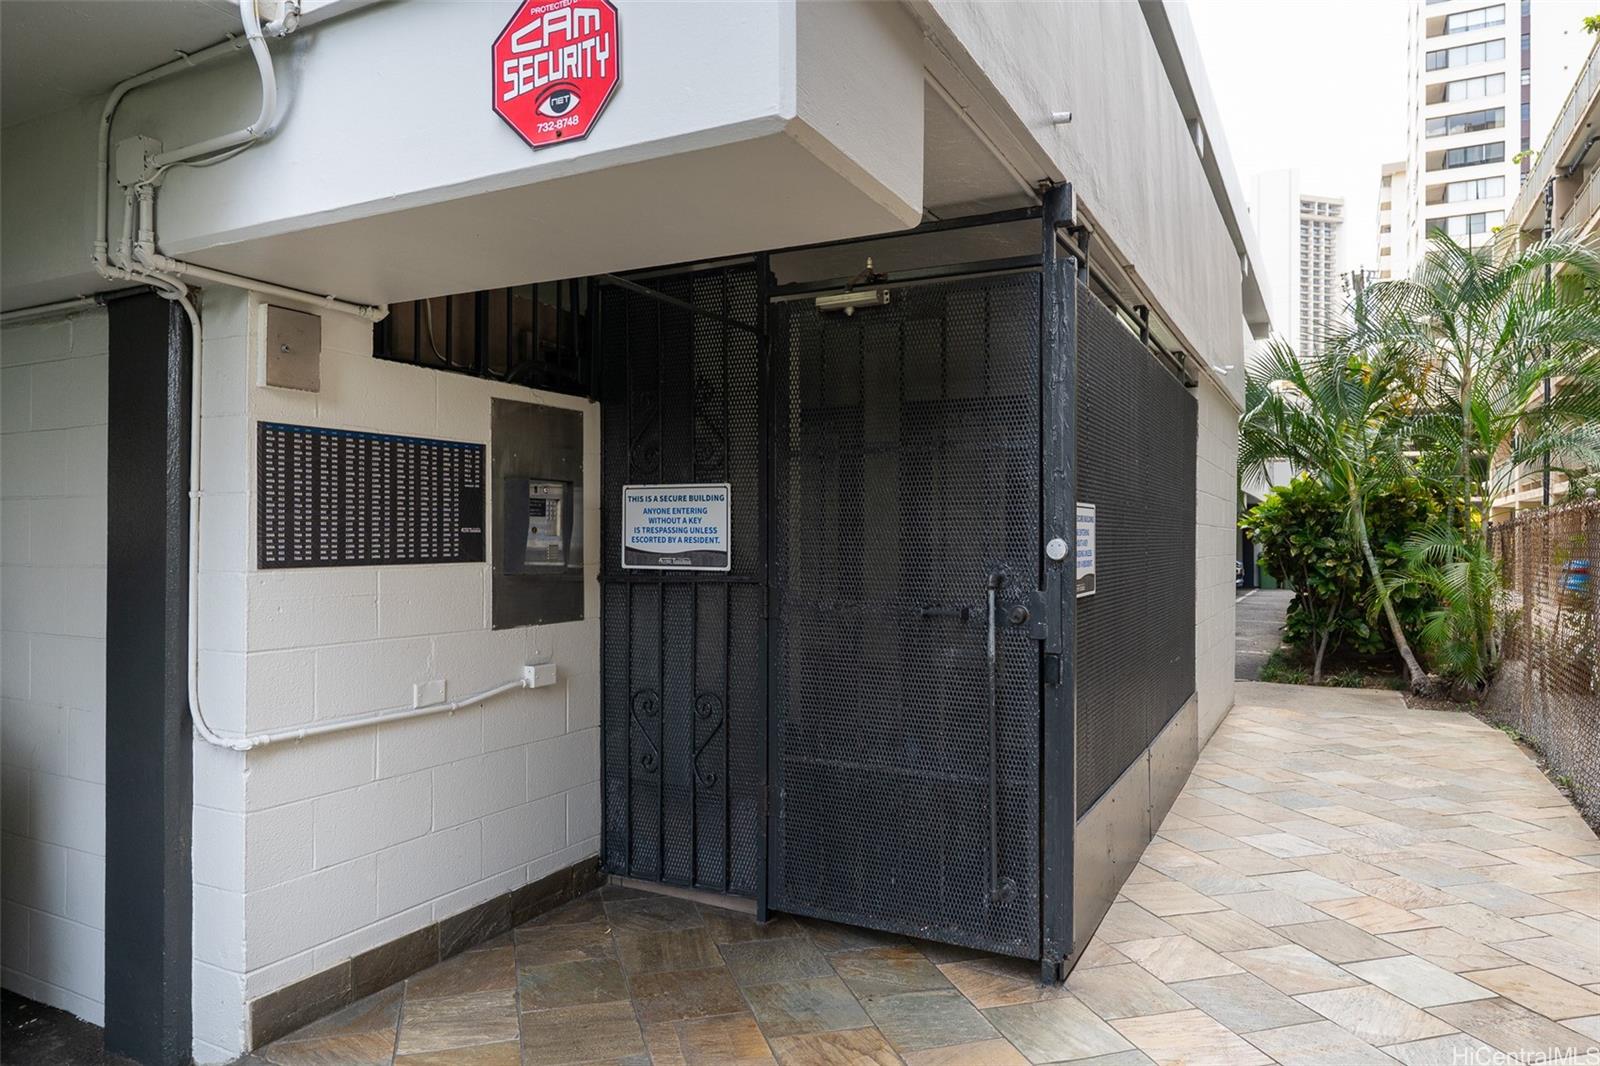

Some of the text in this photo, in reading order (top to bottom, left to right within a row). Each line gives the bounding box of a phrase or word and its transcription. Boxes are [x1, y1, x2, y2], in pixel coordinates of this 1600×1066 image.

[511, 7, 600, 53] CAM
[503, 32, 609, 102] SECURITY
[536, 115, 579, 133] 732-8748
[689, 494, 725, 502] BUILDING
[643, 507, 708, 515] ANYONE ENTERING
[684, 536, 721, 544] RESIDENT.
